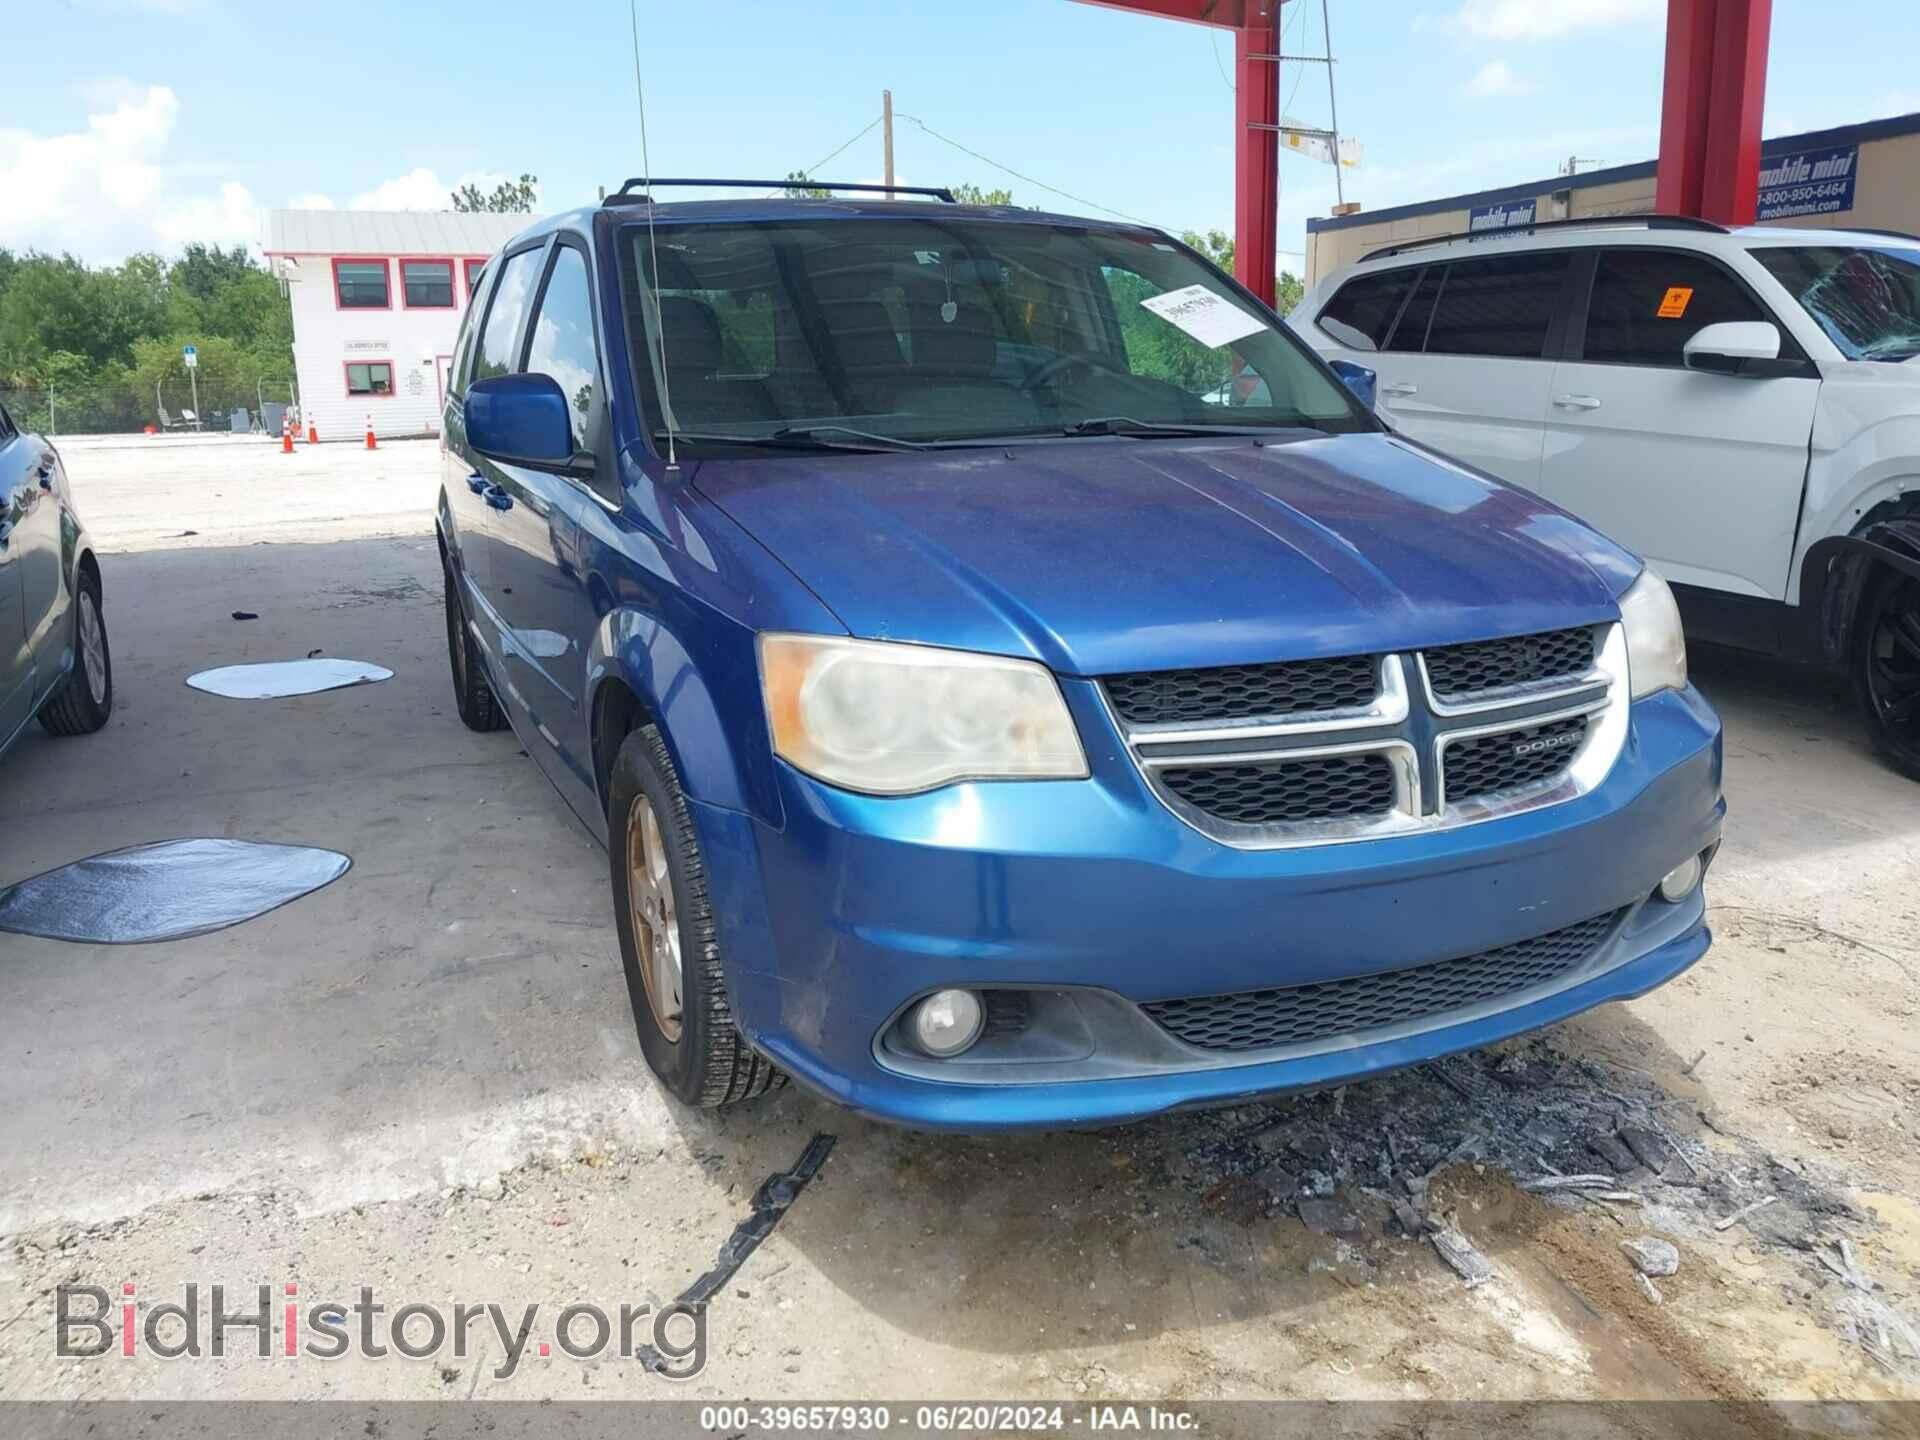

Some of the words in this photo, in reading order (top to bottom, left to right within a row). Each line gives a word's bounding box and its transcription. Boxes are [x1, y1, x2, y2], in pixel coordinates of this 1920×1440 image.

[1758, 156, 1812, 188] mobile
[1811, 152, 1857, 180] mini
[1757, 182, 1848, 206] 1-800-950-6464
[1760, 200, 1841, 219] mobilemini.com
[1516, 731, 1585, 754] DODGE
